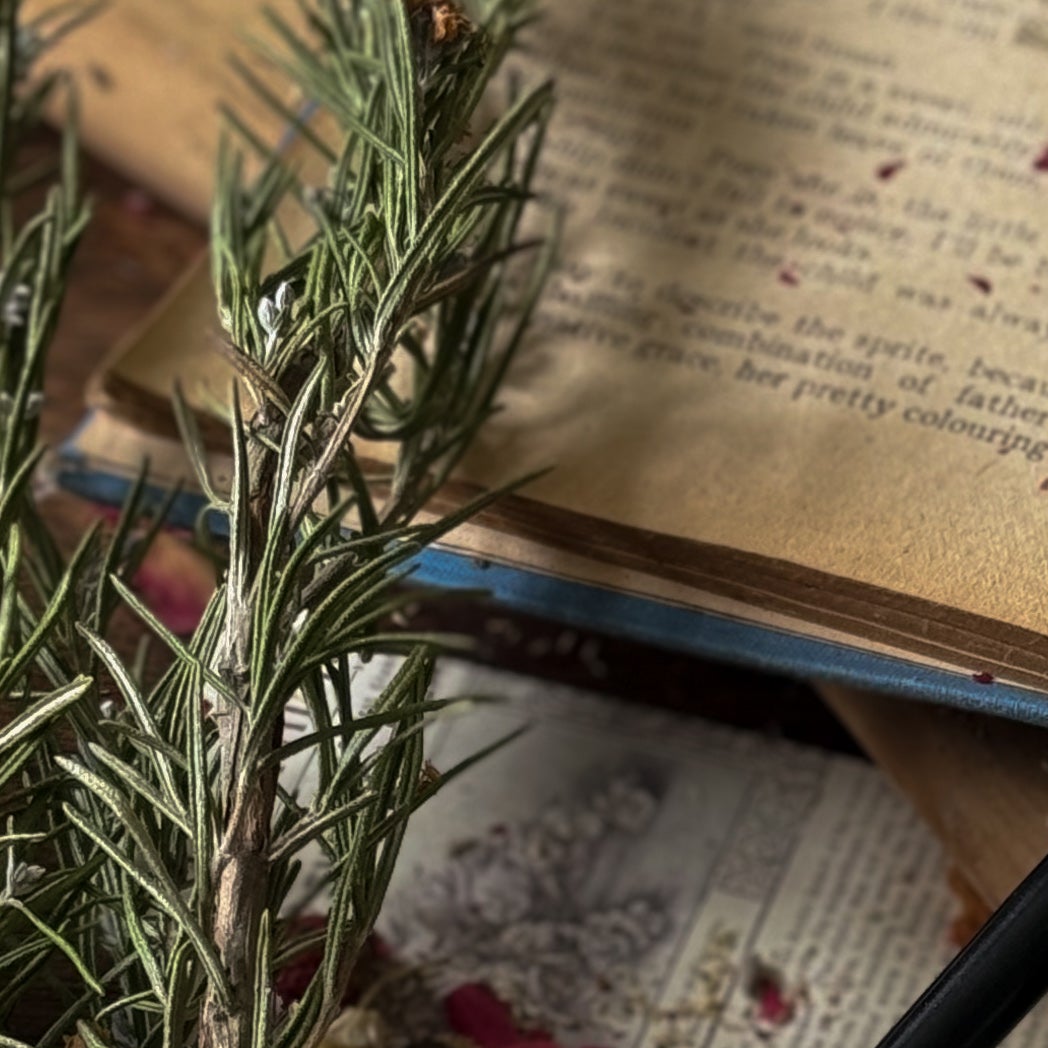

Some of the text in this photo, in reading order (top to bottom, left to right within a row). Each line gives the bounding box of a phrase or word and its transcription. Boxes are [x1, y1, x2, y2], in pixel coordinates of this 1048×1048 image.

[853, 333, 949, 380] sprite,
[734, 358, 790, 389] her
[791, 378, 897, 420] pretty
[897, 373, 936, 397] of
